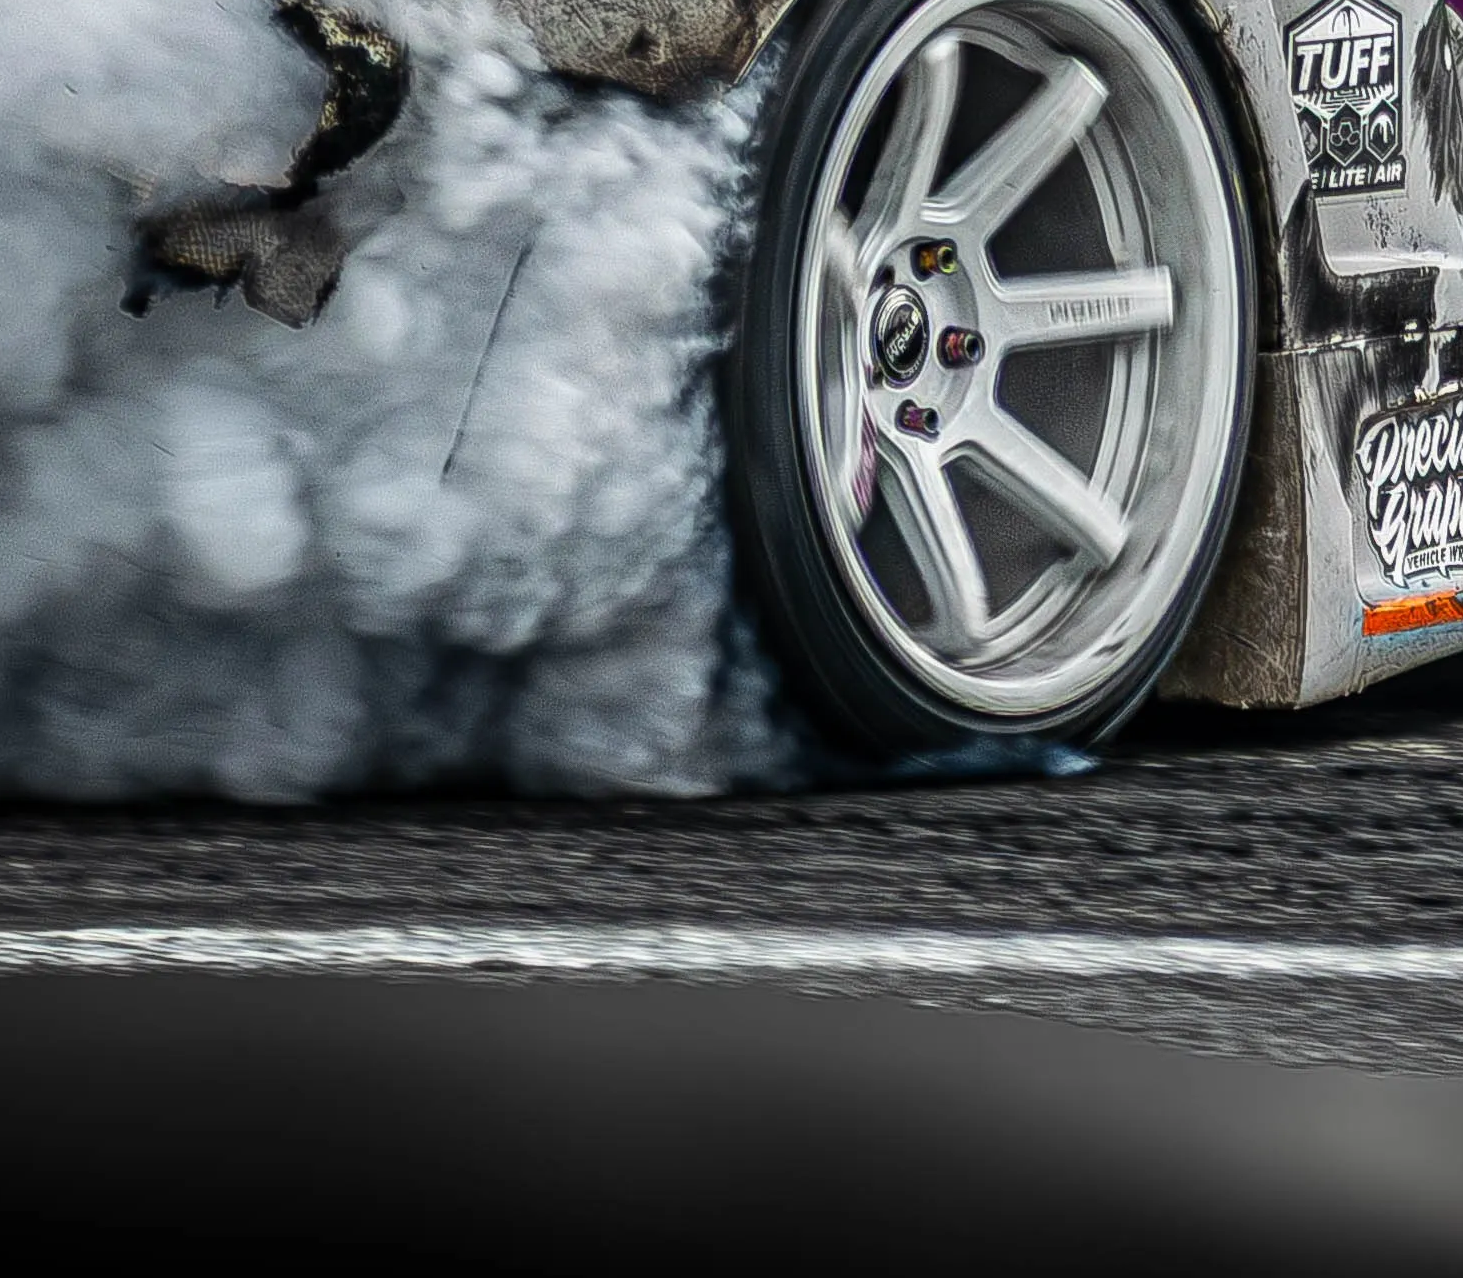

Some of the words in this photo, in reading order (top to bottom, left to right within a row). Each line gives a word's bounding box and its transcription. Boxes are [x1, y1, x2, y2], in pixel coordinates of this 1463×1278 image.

[1296, 35, 1393, 92] TUFF
[1328, 166, 1367, 189] LITE
[1373, 162, 1404, 184] AIR
[1406, 547, 1447, 571] VEHICLE
